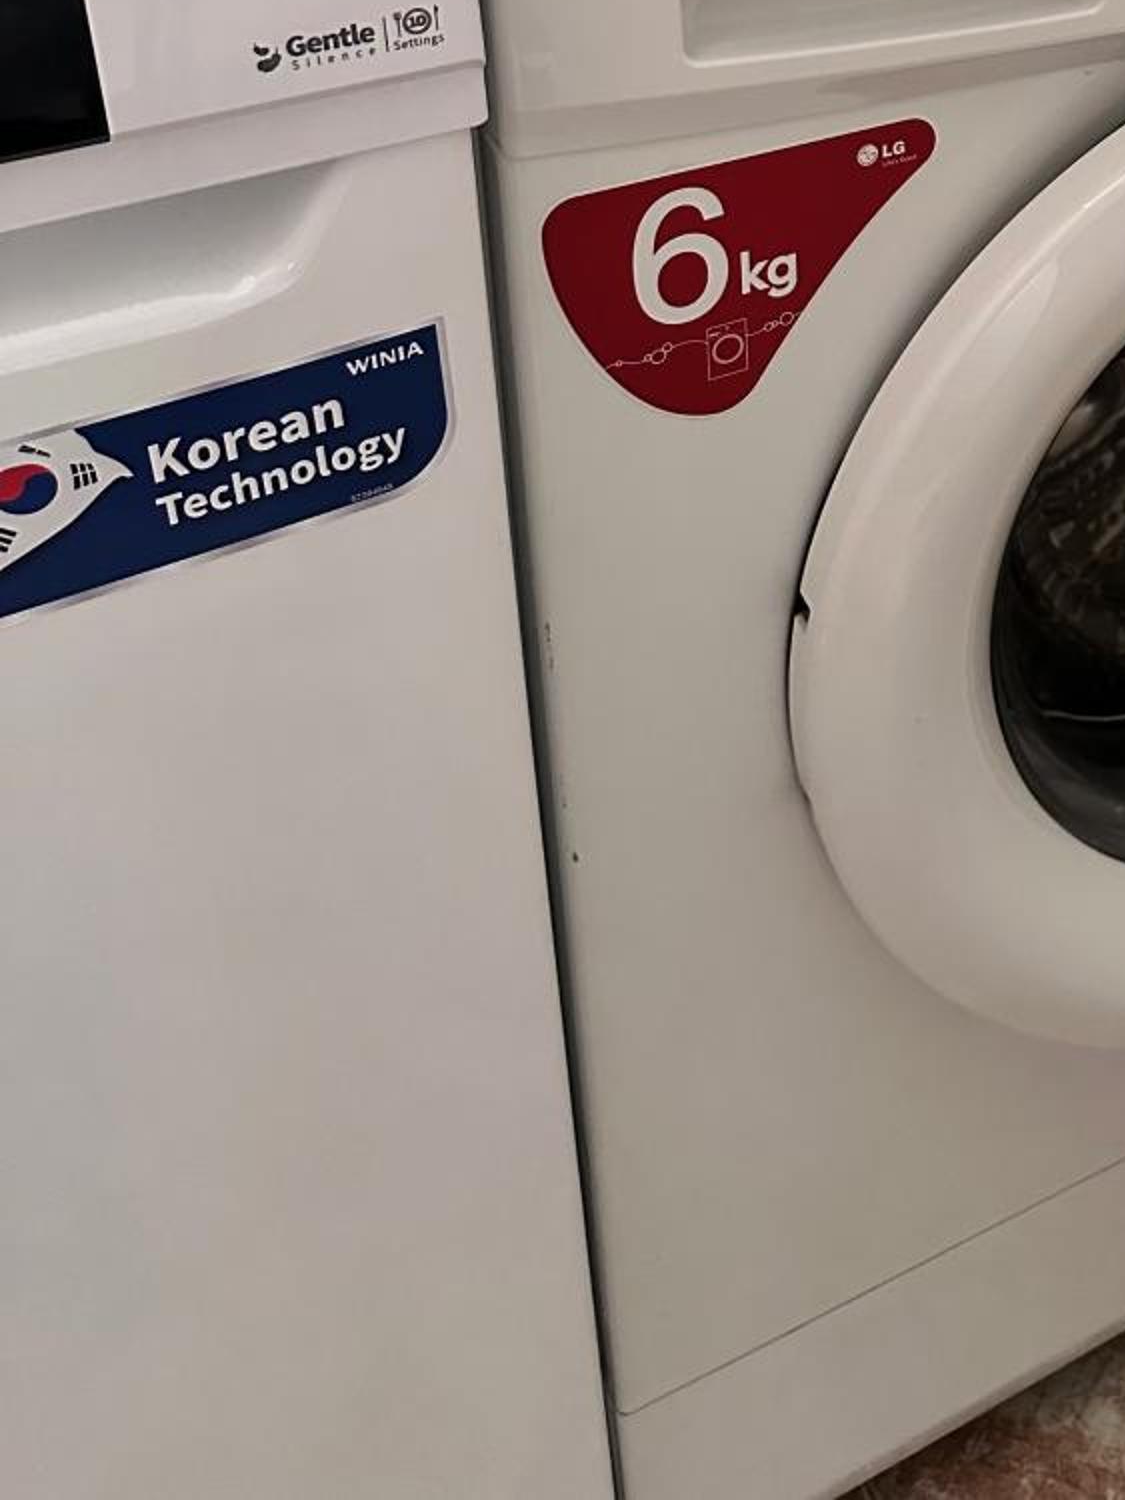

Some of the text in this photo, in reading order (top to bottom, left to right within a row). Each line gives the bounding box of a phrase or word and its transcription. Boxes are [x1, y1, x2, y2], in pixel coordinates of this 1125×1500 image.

[408, 13, 427, 29] 10
[285, 23, 376, 58] Gentle
[392, 33, 446, 52] Settings
[291, 47, 377, 71] Silence
[882, 140, 906, 158] LG
[631, 185, 800, 326] 6 kg
[345, 341, 425, 377] WINIA
[146, 398, 346, 485] Korean
[154, 426, 407, 527] Technology
